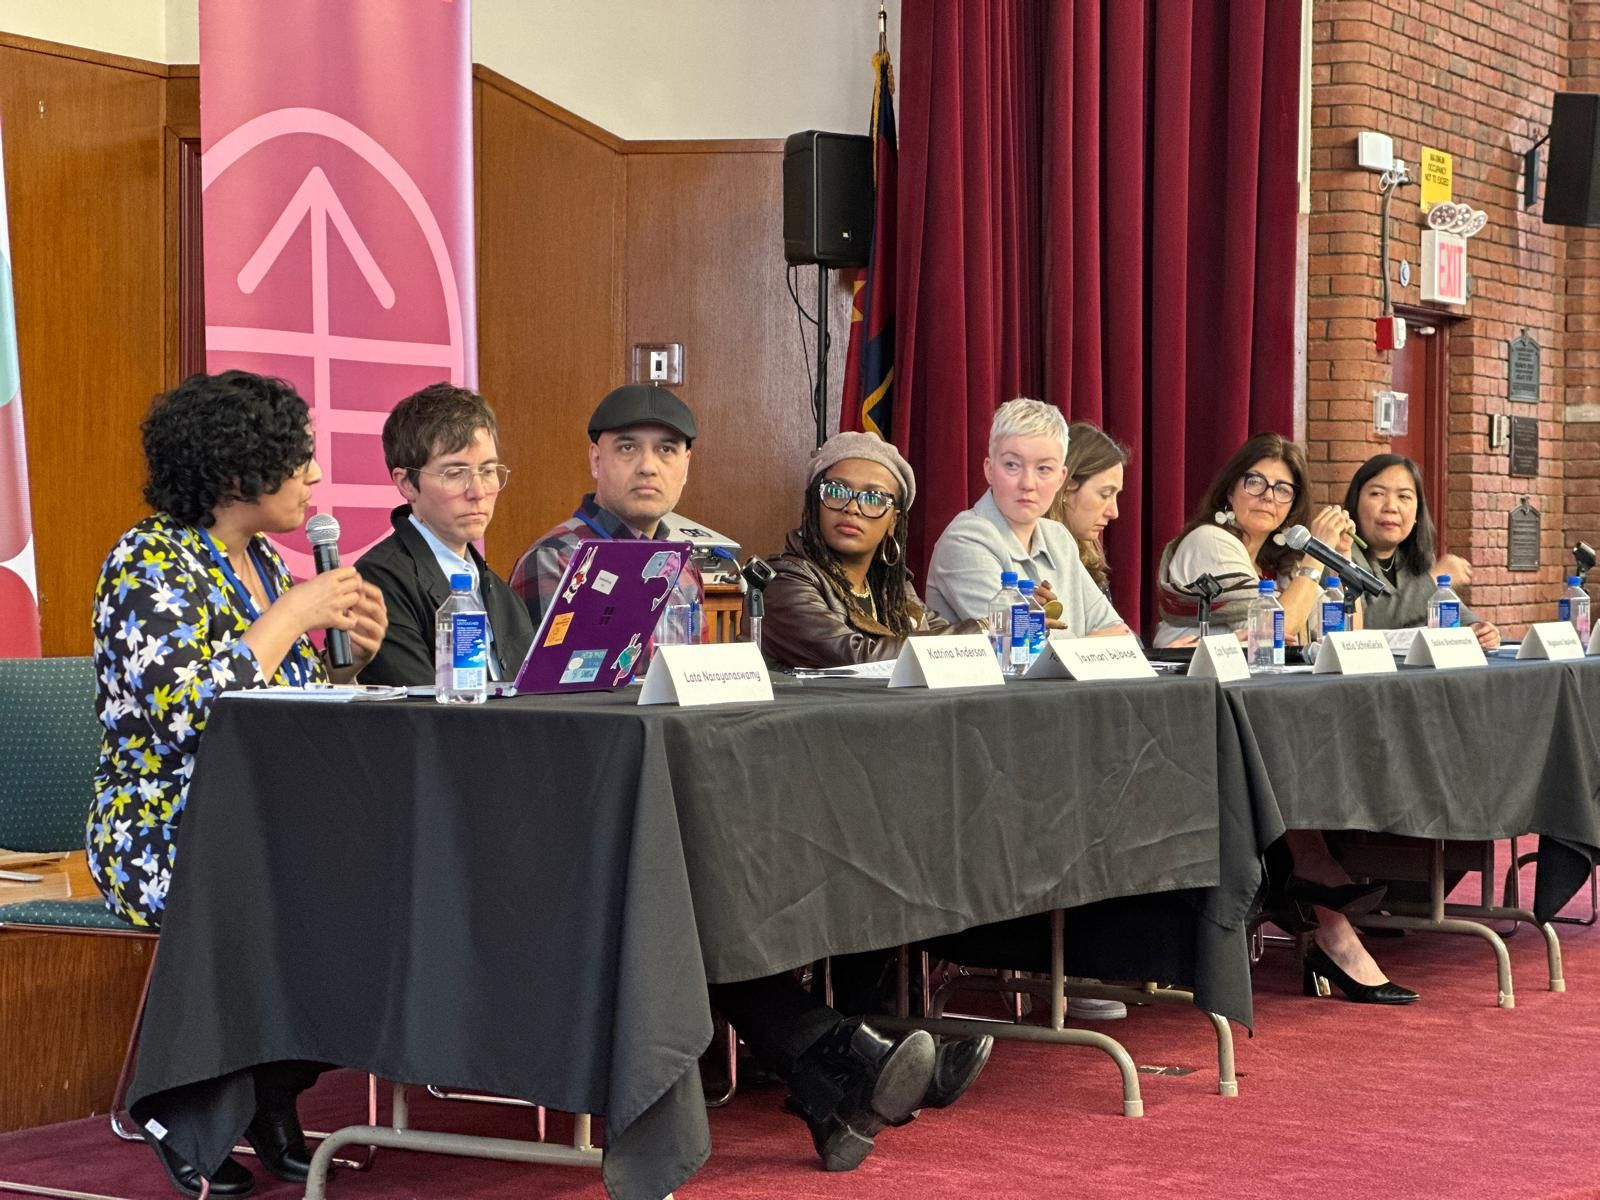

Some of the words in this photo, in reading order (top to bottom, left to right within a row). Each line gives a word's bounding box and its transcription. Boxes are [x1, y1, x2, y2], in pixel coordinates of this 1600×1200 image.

[1439, 242, 1463, 298] EXIT
[927, 647, 956, 660] Katrina
[955, 645, 988, 659] Anderson
[684, 671, 703, 683] Lata
[702, 670, 761, 684] Narayanaswamy
